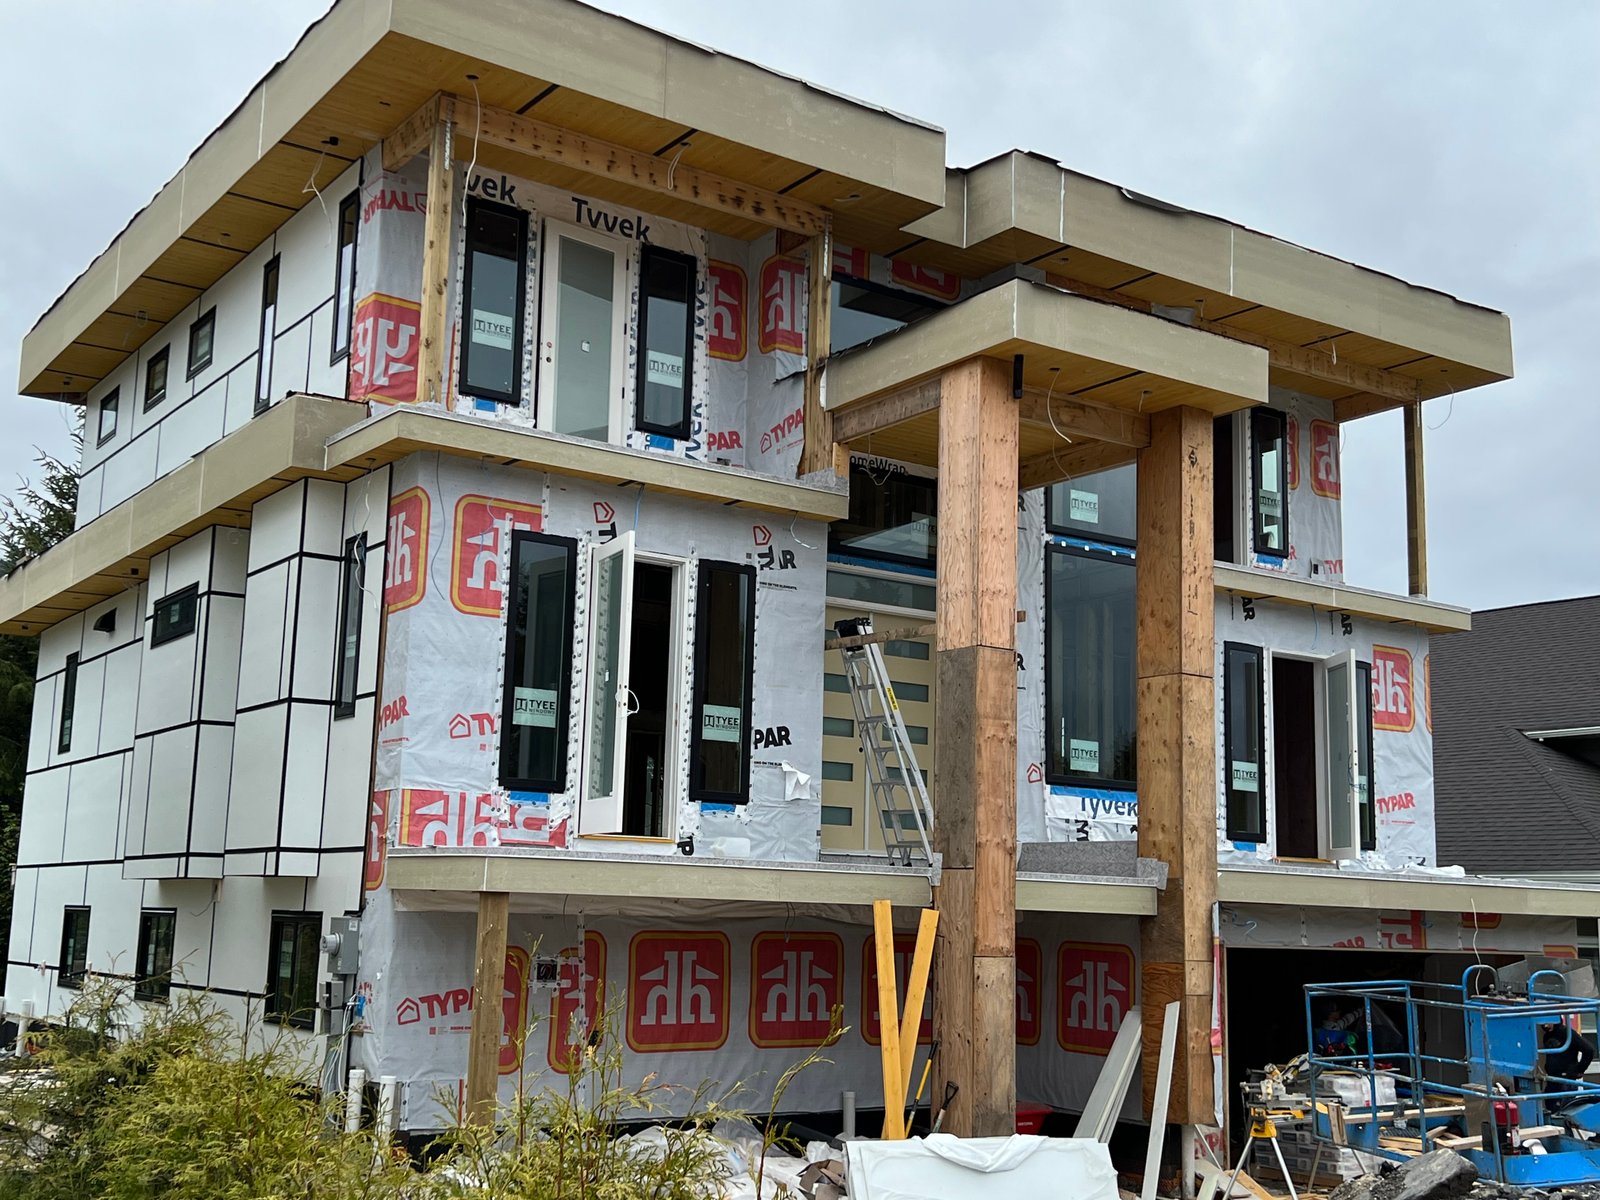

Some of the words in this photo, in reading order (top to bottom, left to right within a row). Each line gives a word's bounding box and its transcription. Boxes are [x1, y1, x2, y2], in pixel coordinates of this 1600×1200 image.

[487, 322, 511, 334] TYEE
[660, 362, 682, 374] TYEE
[529, 700, 555, 710] TYEE
[716, 716, 739, 726] TYEE
[753, 726, 792, 750] PAR
[1080, 749, 1098, 758] TYEE
[1242, 770, 1257, 779] TYEE
[1377, 792, 1416, 814] TYPAR
